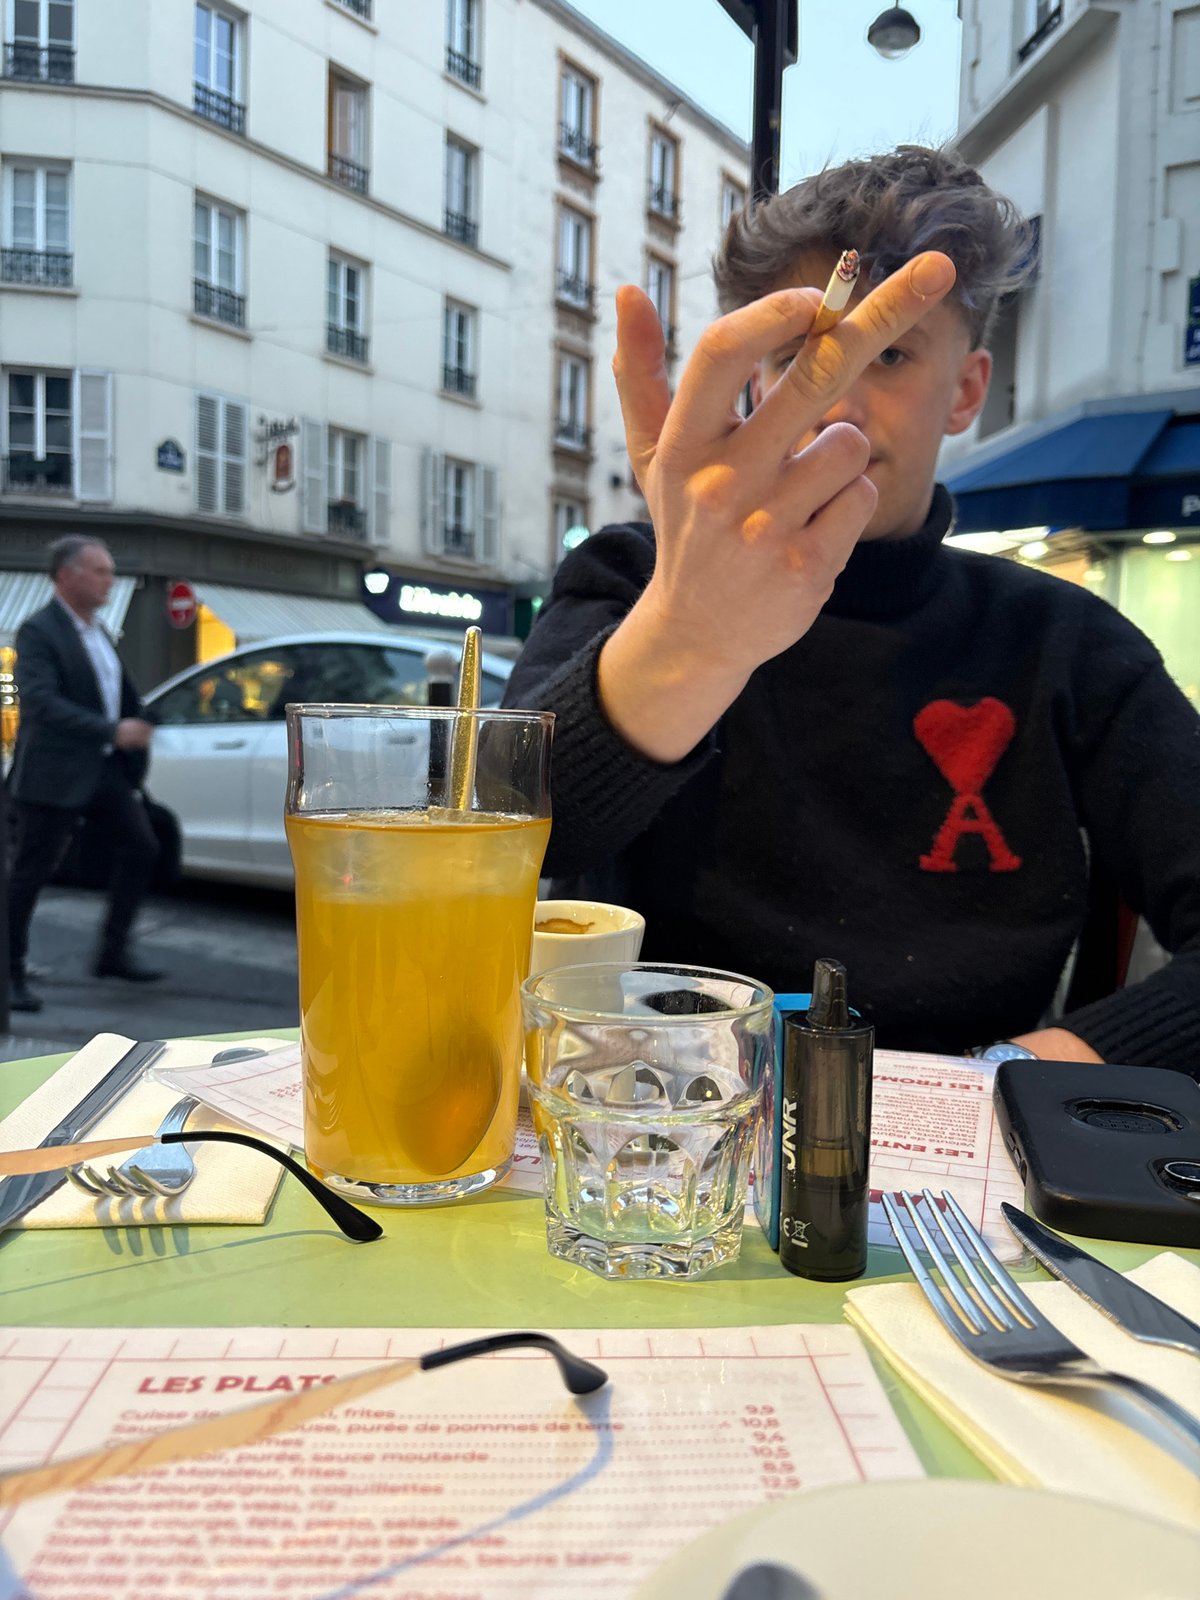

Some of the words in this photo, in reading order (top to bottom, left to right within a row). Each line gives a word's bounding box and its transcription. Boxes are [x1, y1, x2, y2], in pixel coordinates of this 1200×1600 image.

[949, 1083, 984, 1091] LES
[934, 1148, 974, 1158] LES
[137, 1376, 206, 1394] LES
[120, 1409, 188, 1420] Cuisse
[344, 1407, 396, 1418] frites
[347, 1421, 408, 1434] purée
[415, 1422, 440, 1432] de
[448, 1423, 538, 1434] pommes
[545, 1422, 570, 1432] de
[576, 1422, 624, 1432] terre
[311, 1452, 374, 1463] sauce
[381, 1451, 488, 1463] moutarde
[291, 1467, 346, 1478] frites
